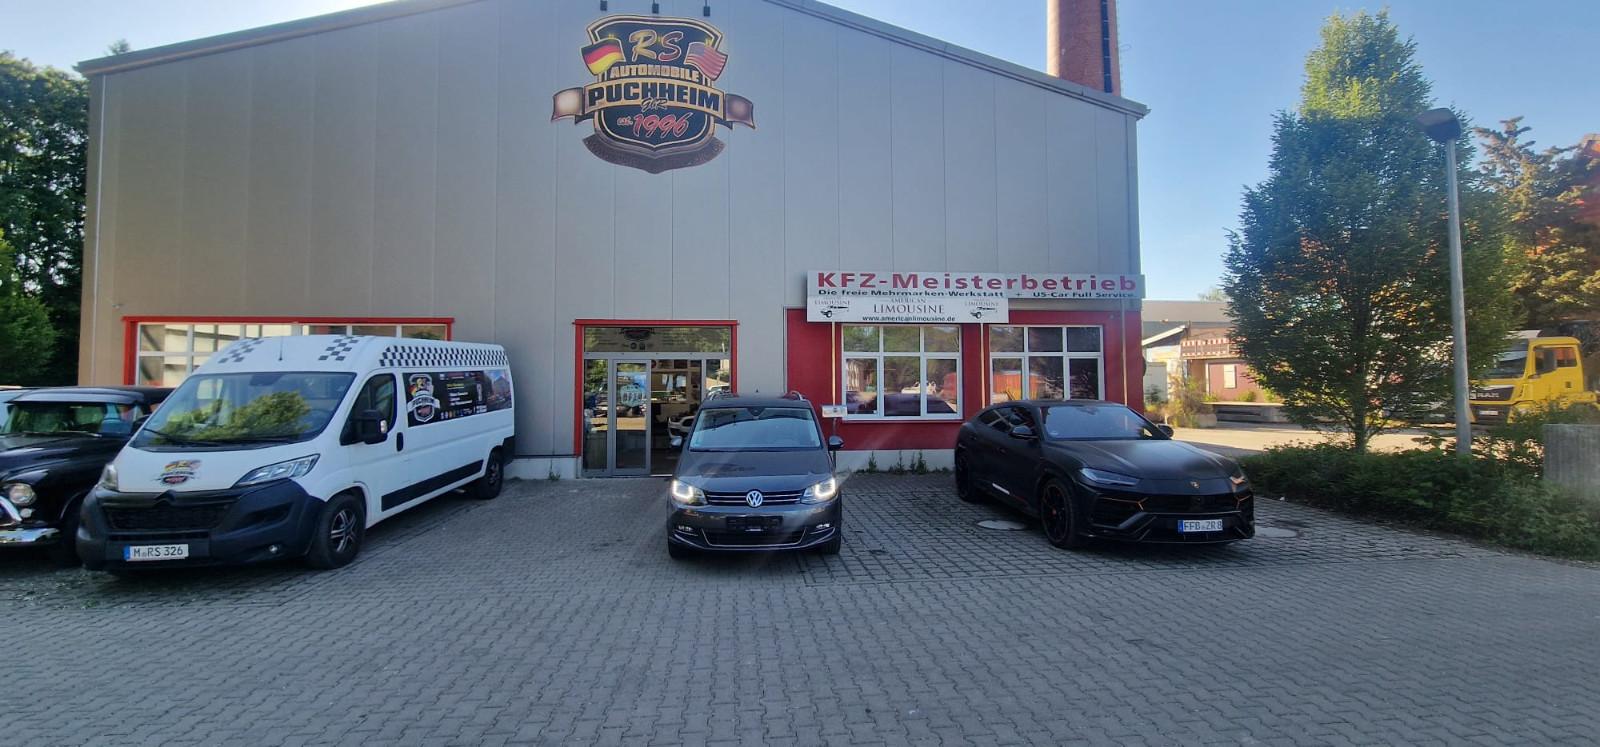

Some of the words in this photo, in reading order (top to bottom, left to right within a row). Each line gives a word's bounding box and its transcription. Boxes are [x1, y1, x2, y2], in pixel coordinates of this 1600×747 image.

[629, 29, 684, 62] RS
[610, 64, 700, 82] AUTOMOBILE
[588, 81, 720, 111] PUCHHEIM
[633, 112, 693, 138] 1996
[817, 272, 1136, 291] KFZ-Meisterbetrieb
[871, 289, 1004, 297] Mehrmarken-Werkstatt
[873, 304, 945, 314] LIMOUSINE
[1184, 521, 1200, 530] FFB
[1206, 521, 1216, 530] ZR
[134, 547, 140, 556] M
[147, 546, 161, 556] RS
[164, 545, 183, 556] 326
